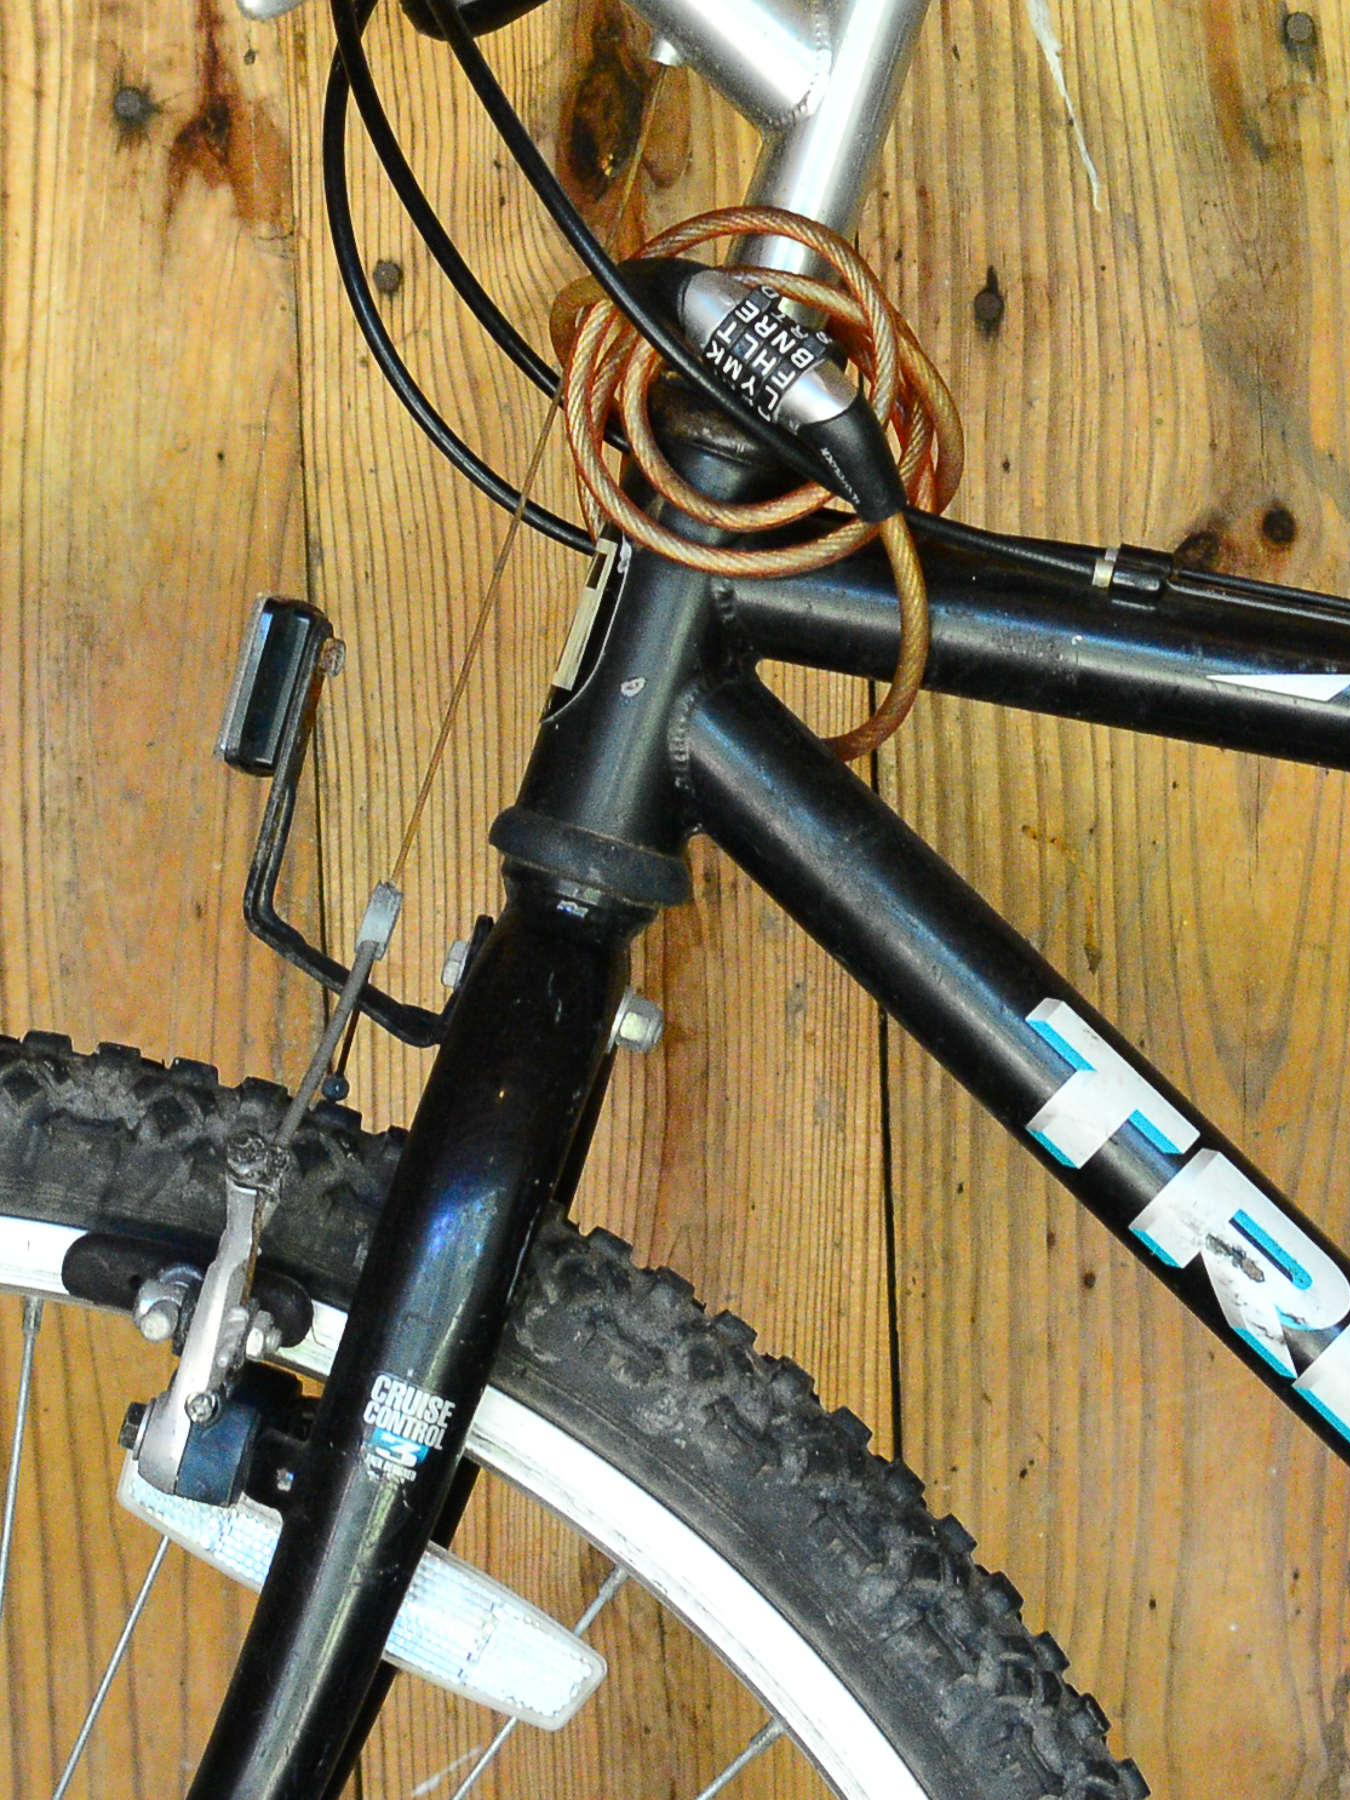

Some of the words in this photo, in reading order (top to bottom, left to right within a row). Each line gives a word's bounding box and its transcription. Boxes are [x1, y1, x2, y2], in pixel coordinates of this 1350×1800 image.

[363, 1400, 445, 1450] CONTROL
[371, 1374, 456, 1429] CRUISE
[375, 1432, 421, 1467] 3
